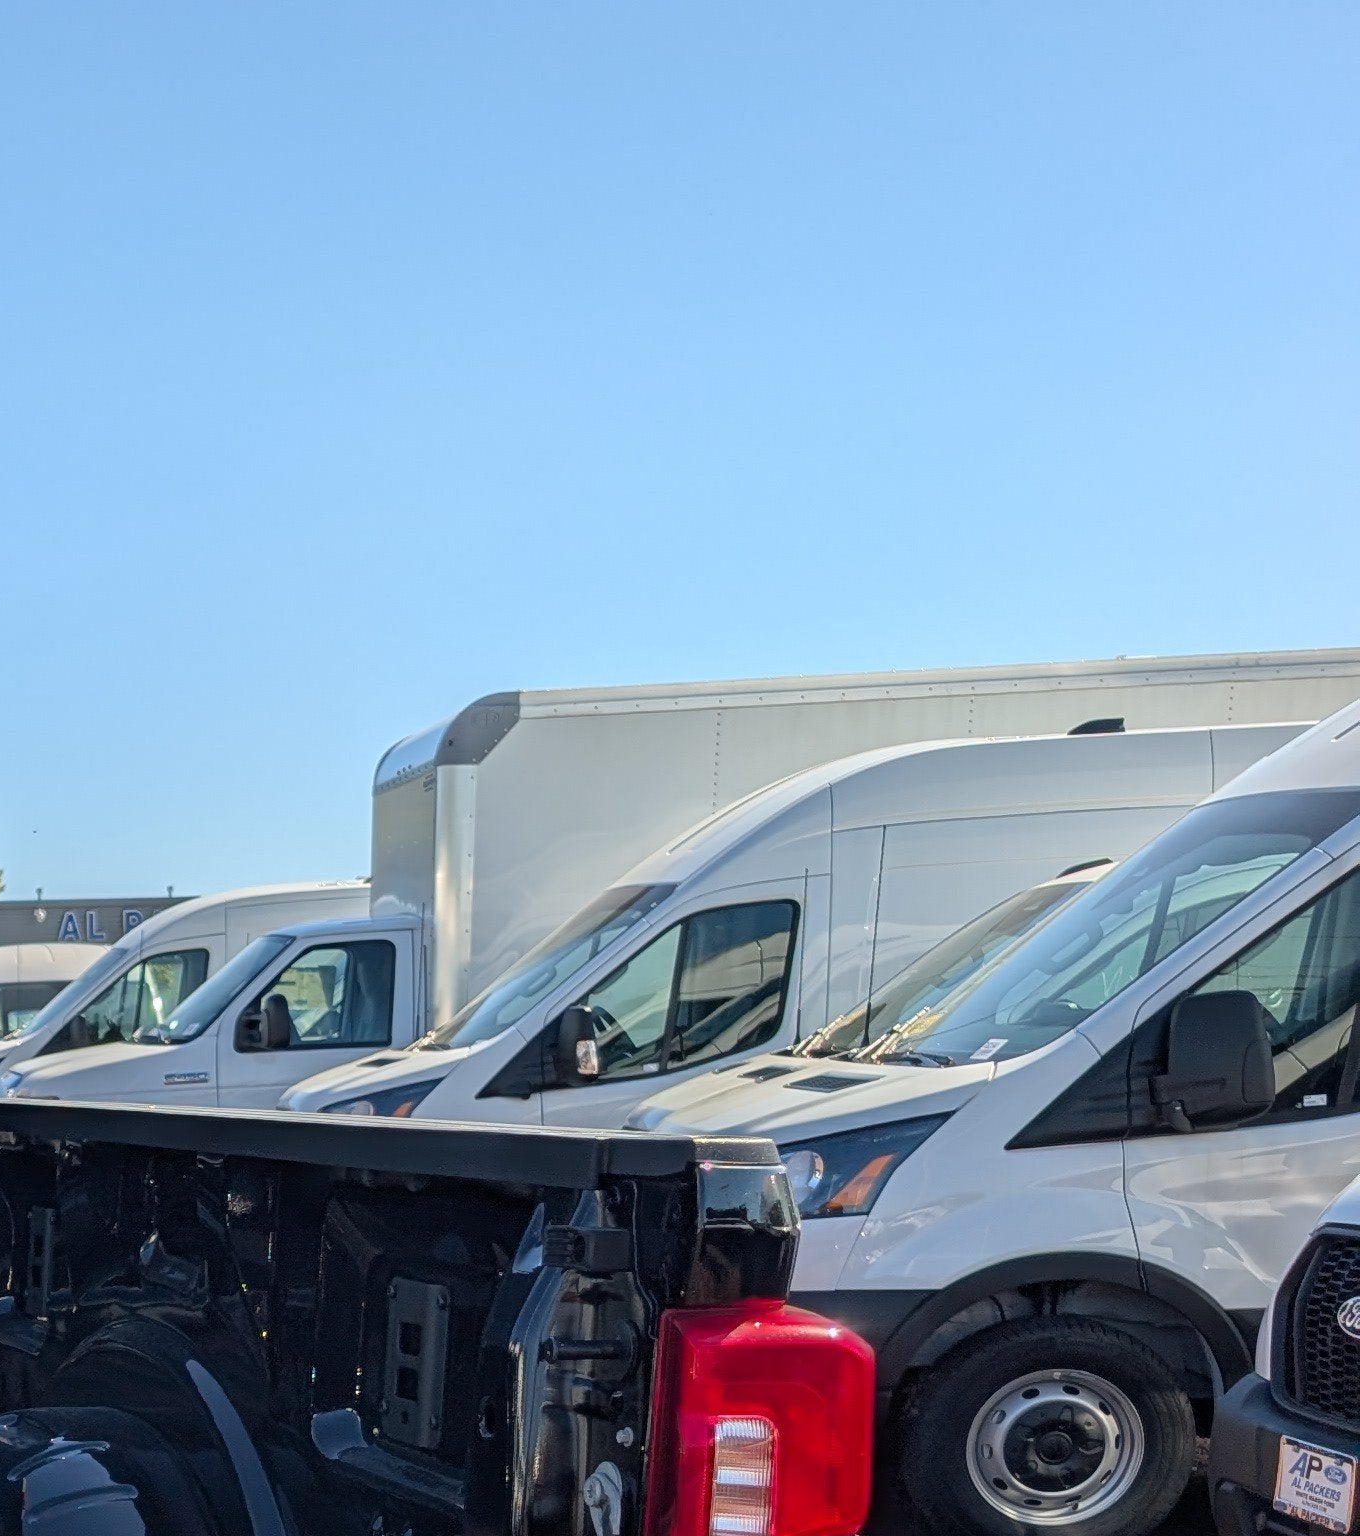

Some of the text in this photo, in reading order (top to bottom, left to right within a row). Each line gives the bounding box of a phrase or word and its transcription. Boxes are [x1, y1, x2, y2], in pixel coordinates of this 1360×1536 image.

[58, 911, 106, 941] AL
[1289, 1452, 1322, 1480] AP
[1303, 1481, 1341, 1502] PACKERS
